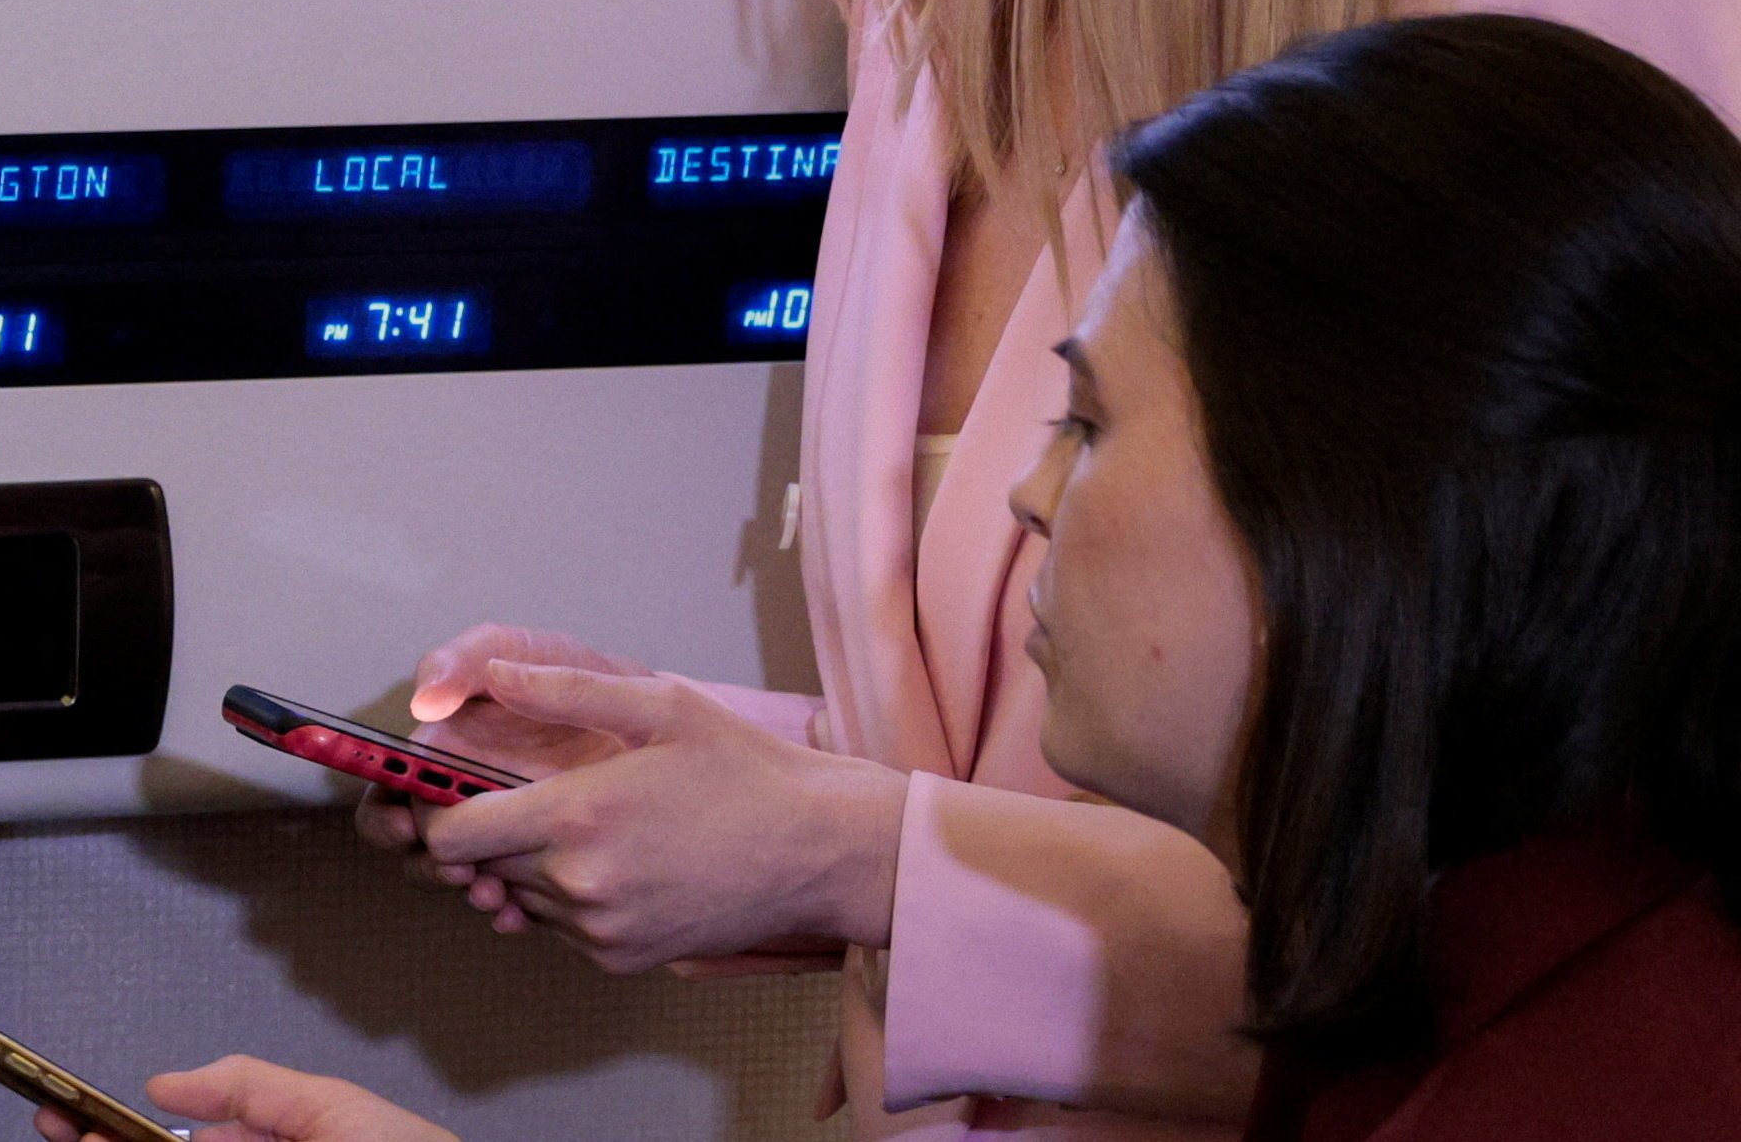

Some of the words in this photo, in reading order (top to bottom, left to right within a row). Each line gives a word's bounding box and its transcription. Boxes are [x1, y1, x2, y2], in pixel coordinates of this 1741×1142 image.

[314, 155, 447, 192] LOCAL
[323, 323, 349, 342] PM
[368, 301, 465, 342] 7:41
